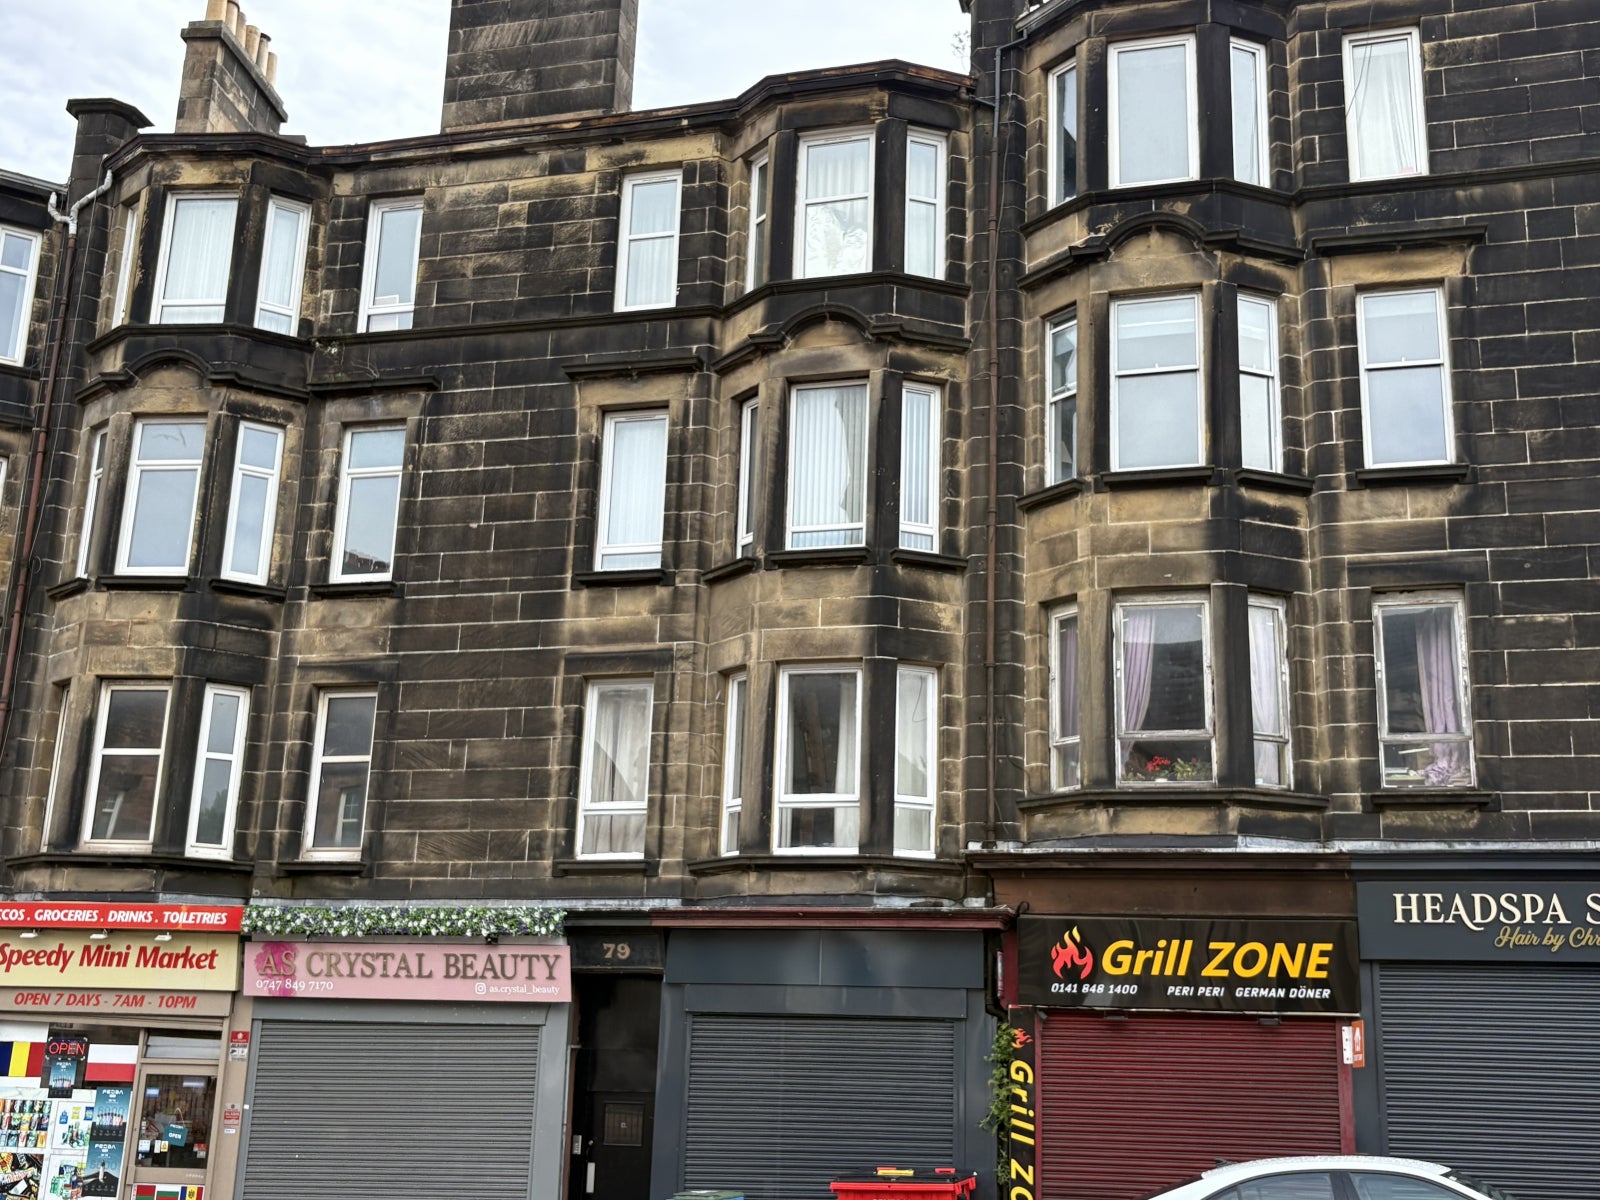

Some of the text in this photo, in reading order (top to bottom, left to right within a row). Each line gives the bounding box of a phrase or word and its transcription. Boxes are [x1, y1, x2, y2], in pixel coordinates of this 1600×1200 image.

[34, 909, 99, 922] GROCERIES
[107, 910, 153, 923] DRINKS
[163, 911, 228, 925] TOILETRIES
[1393, 892, 1600, 931] HEADSPA S
[1494, 926, 1540, 949] Hair
[1542, 927, 1566, 953] by
[0, 943, 219, 974] Speedy Mini Market
[602, 942, 631, 960] 79
[1102, 939, 1334, 978] Grill ZONE
[259, 950, 561, 980] AS CRYSTAL BEAUTY
[255, 978, 334, 991] 0747 849 7170
[489, 984, 560, 995] as.crystal_beauty
[1051, 983, 1138, 995] 0141 848 1400
[1167, 985, 1331, 999] PERI PERI GERMAN DÖNER
[14, 992, 52, 1005] OPEN
[54, 993, 64, 1006] 7
[65, 993, 102, 1007] DAYS
[112, 994, 146, 1008] 7AM
[158, 995, 197, 1009] 10PM
[48, 1042, 86, 1055] OPEN
[1010, 1060, 1035, 1146] Grill
